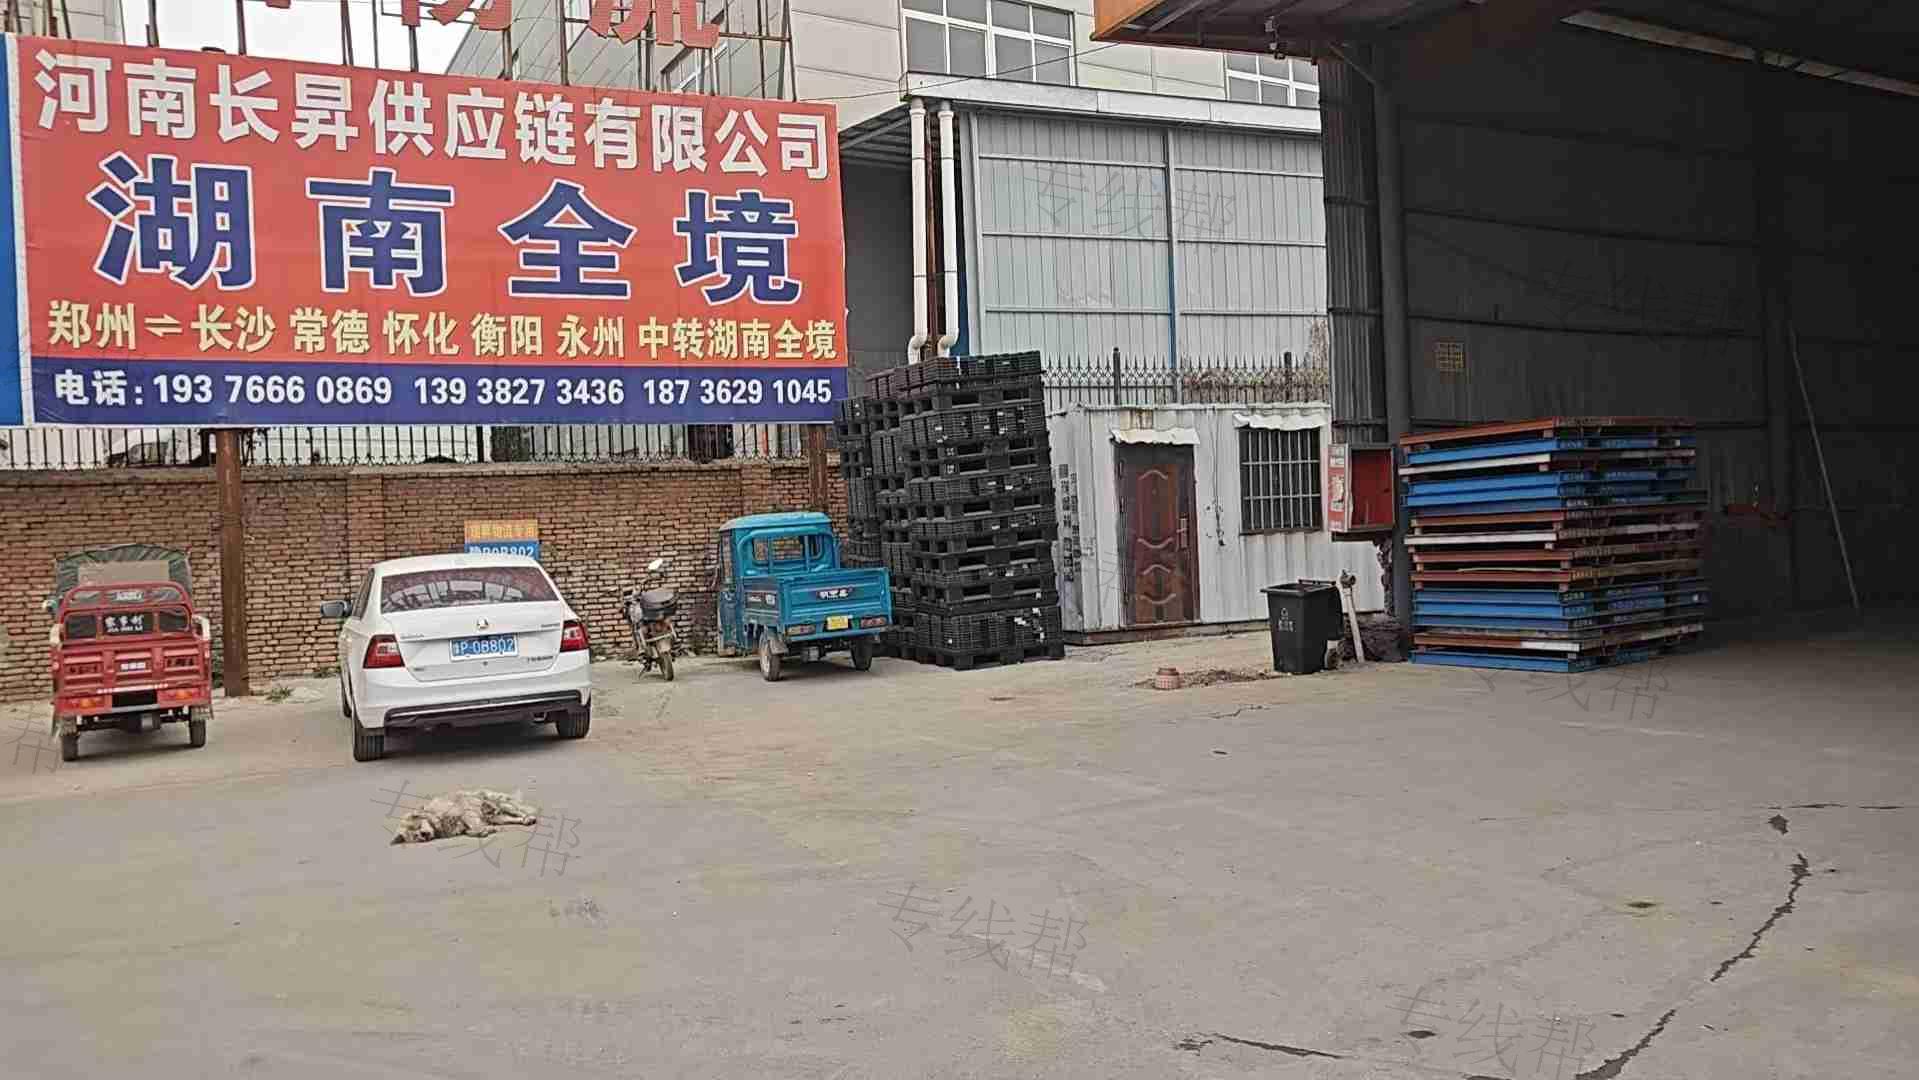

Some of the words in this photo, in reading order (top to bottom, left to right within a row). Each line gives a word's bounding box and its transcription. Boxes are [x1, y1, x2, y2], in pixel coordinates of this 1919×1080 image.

[34, 48, 831, 181] 河南长昇供应链有限公司
[87, 152, 803, 306] 湖南全境
[48, 299, 137, 351] 郑州
[190, 303, 276, 353] 长沙
[289, 307, 370, 355] 常德
[382, 310, 459, 356] 怀化
[470, 312, 543, 357] 衡阳
[557, 314, 624, 359] 永州
[638, 315, 838, 361] 中转湖南全境
[154, 374, 213, 404] 193
[224, 375, 306, 405] 7666
[316, 376, 393, 405] 0869
[413, 376, 467, 405] 139
[476, 378, 546, 406] 3827
[556, 378, 625, 406] 3436
[643, 378, 690, 406] 187
[700, 378, 763, 406] 3629
[773, 379, 832, 406] 1045
